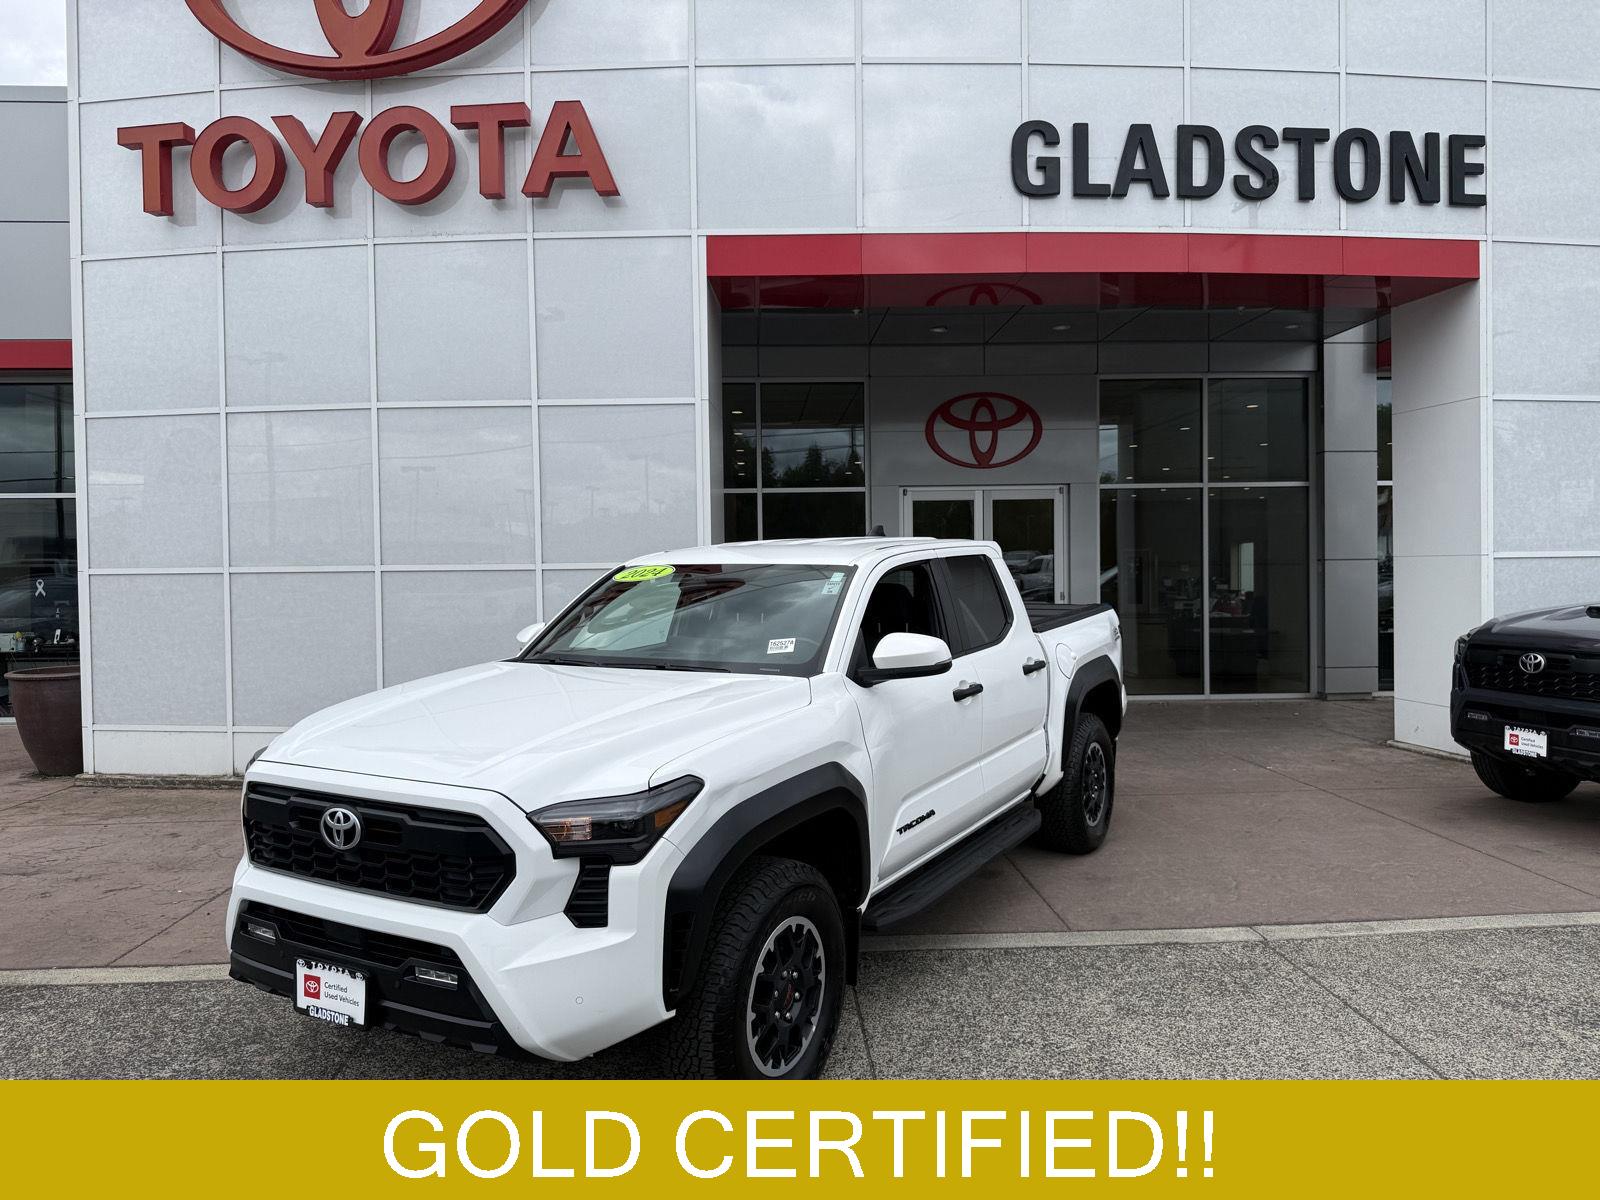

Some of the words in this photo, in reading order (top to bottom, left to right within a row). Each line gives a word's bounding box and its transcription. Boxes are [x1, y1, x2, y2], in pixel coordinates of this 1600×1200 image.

[118, 100, 620, 216] TOYOTA
[1011, 120, 1487, 207] GLADSTONE
[620, 567, 668, 579] 2024
[896, 809, 936, 835] TACOMA
[311, 961, 349, 975] TOYOTA
[324, 981, 348, 994] Certified
[324, 991, 339, 1001] Used
[339, 994, 360, 1007] Vehicles
[309, 1005, 349, 1026] GLADSTONE
